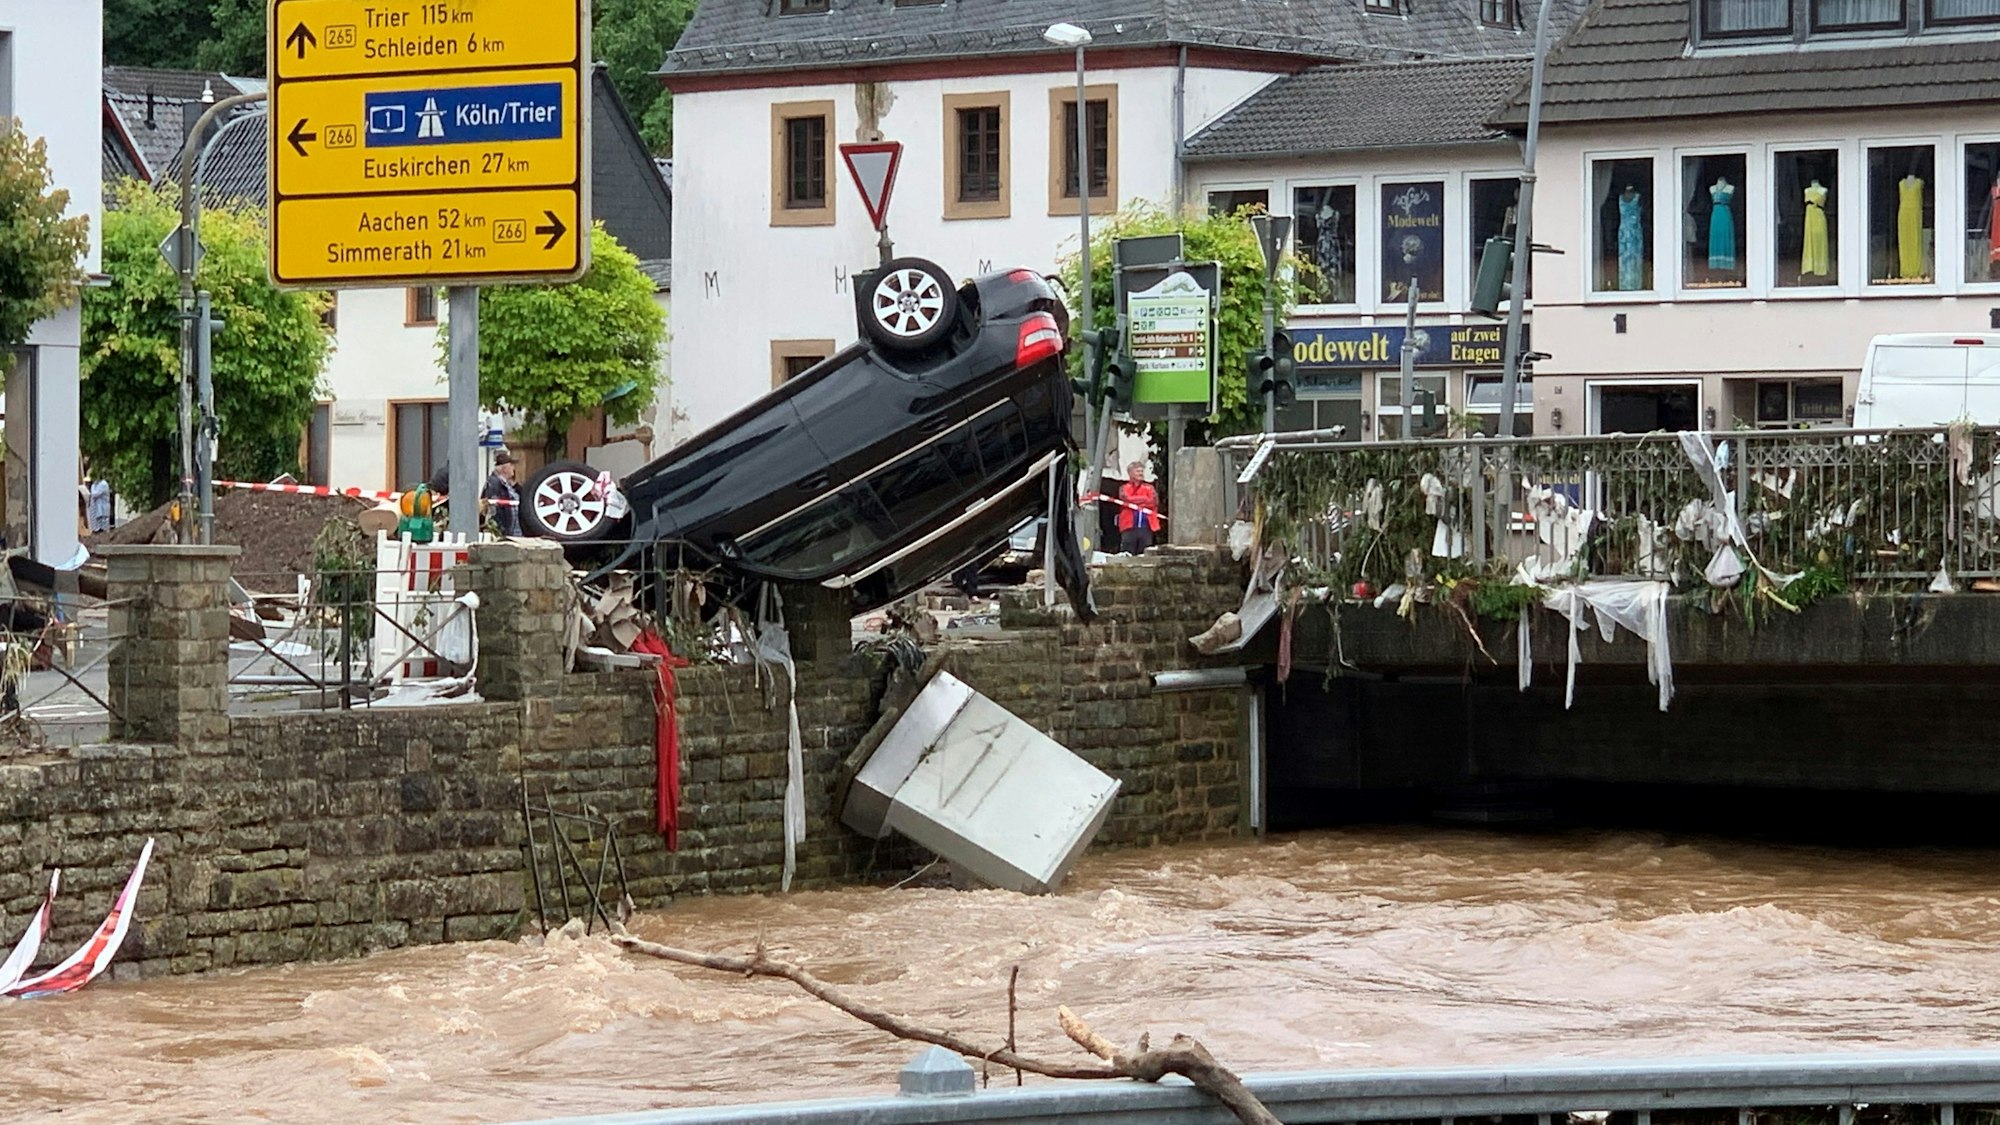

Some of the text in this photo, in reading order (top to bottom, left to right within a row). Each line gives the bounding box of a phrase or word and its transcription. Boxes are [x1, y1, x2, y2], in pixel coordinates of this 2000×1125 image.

[365, 5, 473, 29] Trier 115 km
[329, 30, 353, 44] 265
[365, 34, 504, 59] Schleiden 6 km
[384, 111, 391, 128] 1
[456, 102, 556, 127] Köln/Trier
[329, 129, 353, 144] 266
[365, 153, 529, 178] Euskirchen 27 km
[359, 209, 486, 232] Aachen 52 km
[1388, 214, 1439, 228] Modewelt
[497, 224, 522, 239] 266
[328, 239, 486, 263] Simmerath 21 km
[1451, 327, 1500, 343] auf zwei
[1294, 332, 1390, 363] odewelt
[1451, 344, 1500, 364] Etagen
